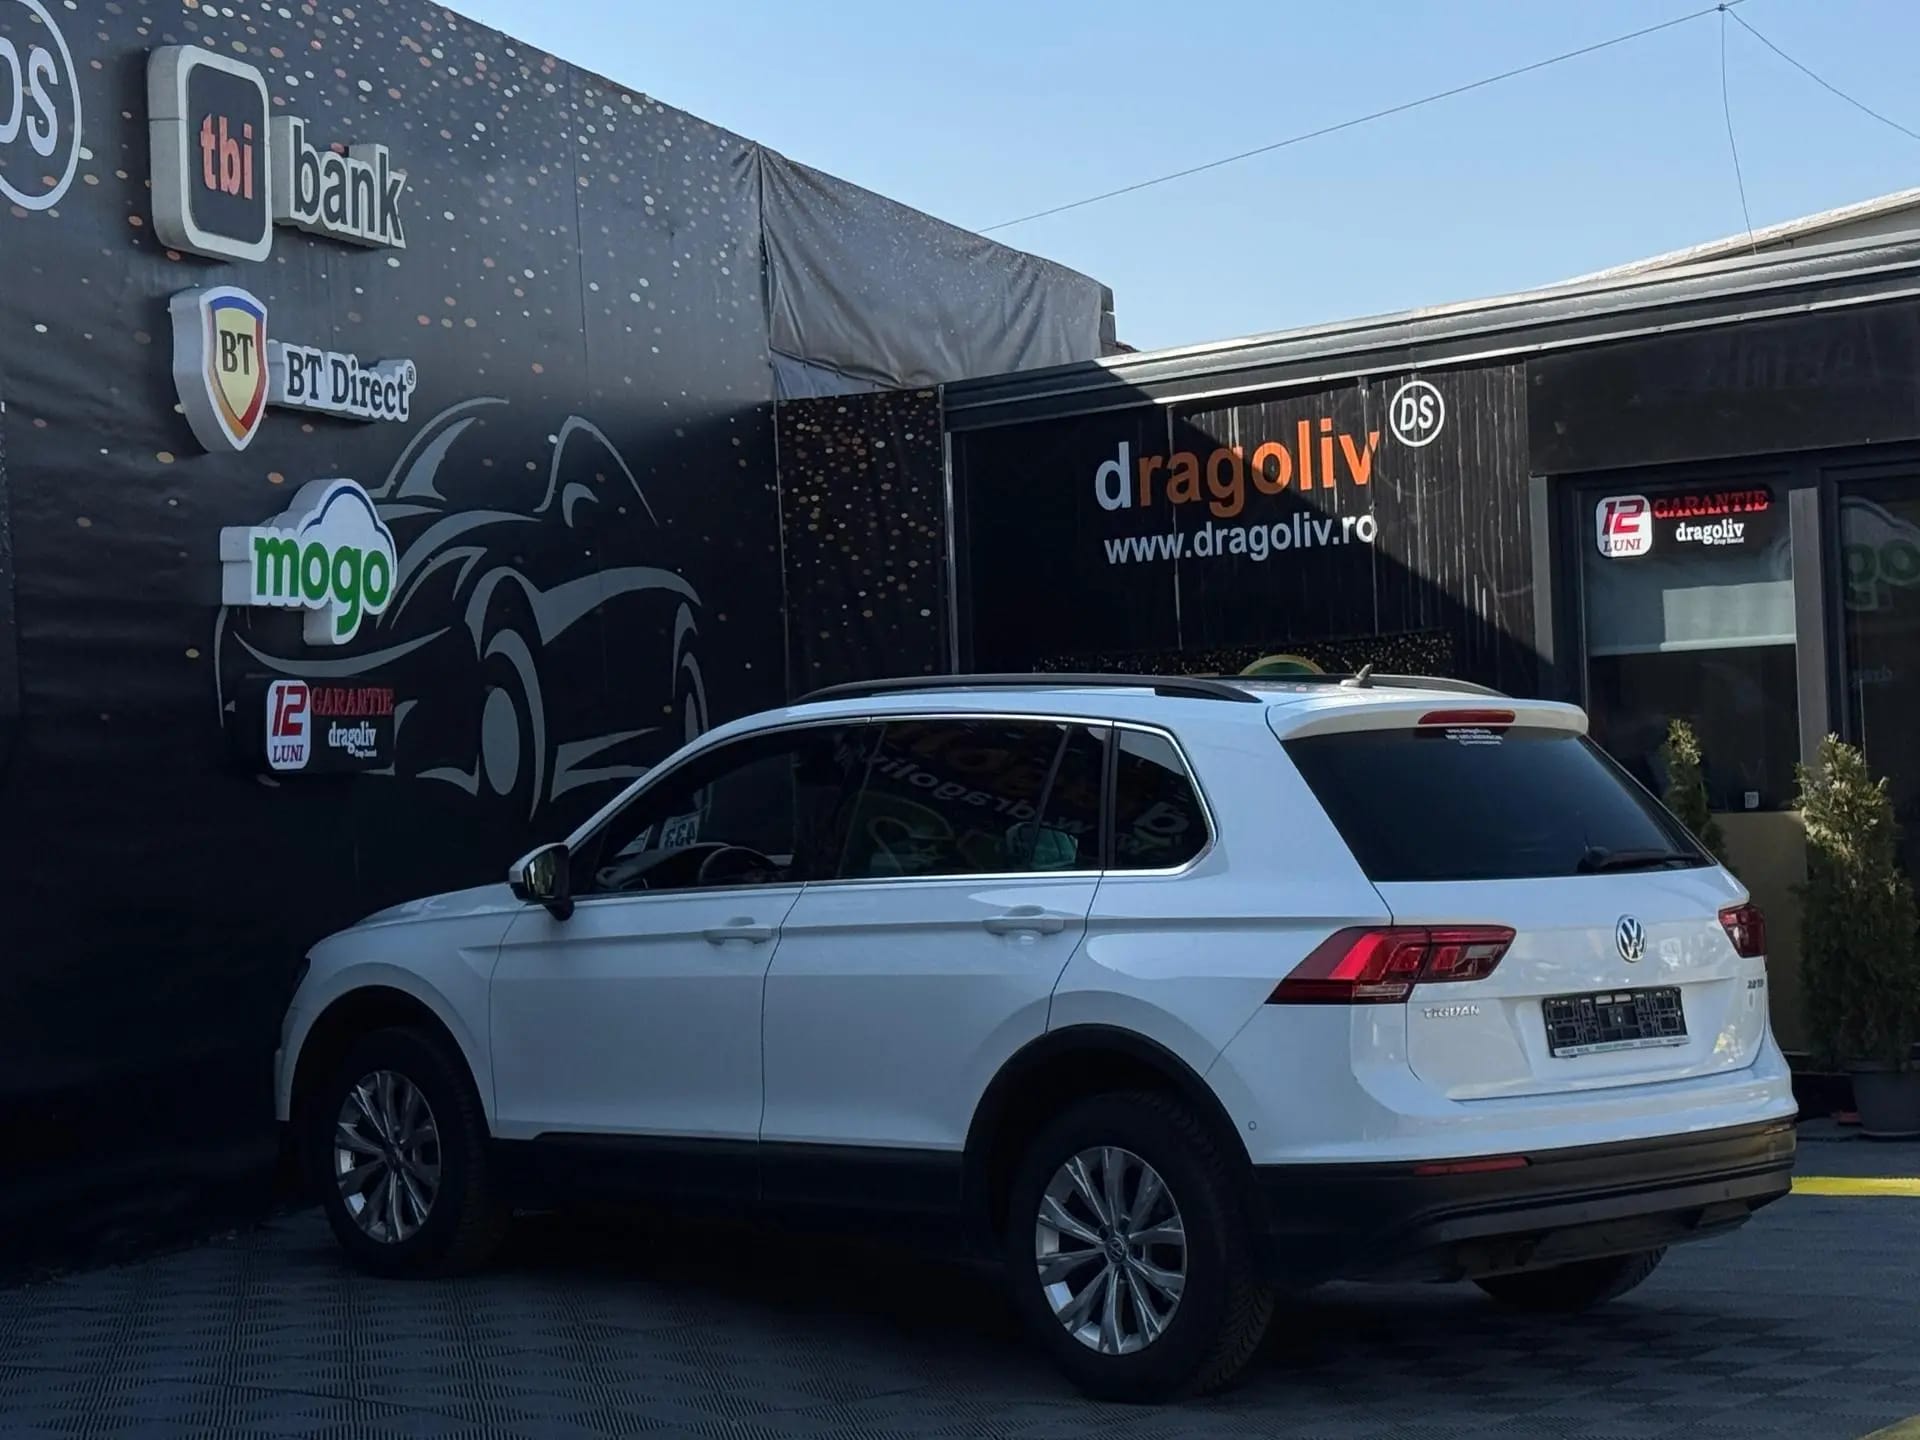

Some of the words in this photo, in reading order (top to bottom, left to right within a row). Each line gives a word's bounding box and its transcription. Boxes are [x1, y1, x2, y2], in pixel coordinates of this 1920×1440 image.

[200, 113, 253, 200] tbi
[293, 124, 403, 242] bank
[219, 330, 254, 376] BT
[287, 350, 323, 399] BT
[1399, 395, 1435, 432] DS
[1095, 417, 1380, 518] dragoliv
[1104, 512, 1379, 562] www.dragoliv.ro
[1602, 499, 1645, 536] 12
[1675, 518, 1745, 545] dragoliv
[1603, 538, 1642, 553] LUNI
[254, 536, 391, 637] mogo
[272, 685, 308, 737] 12
[311, 687, 394, 716] GARANTIE
[272, 744, 304, 763] LUNI
[328, 720, 377, 755] dragoliv
